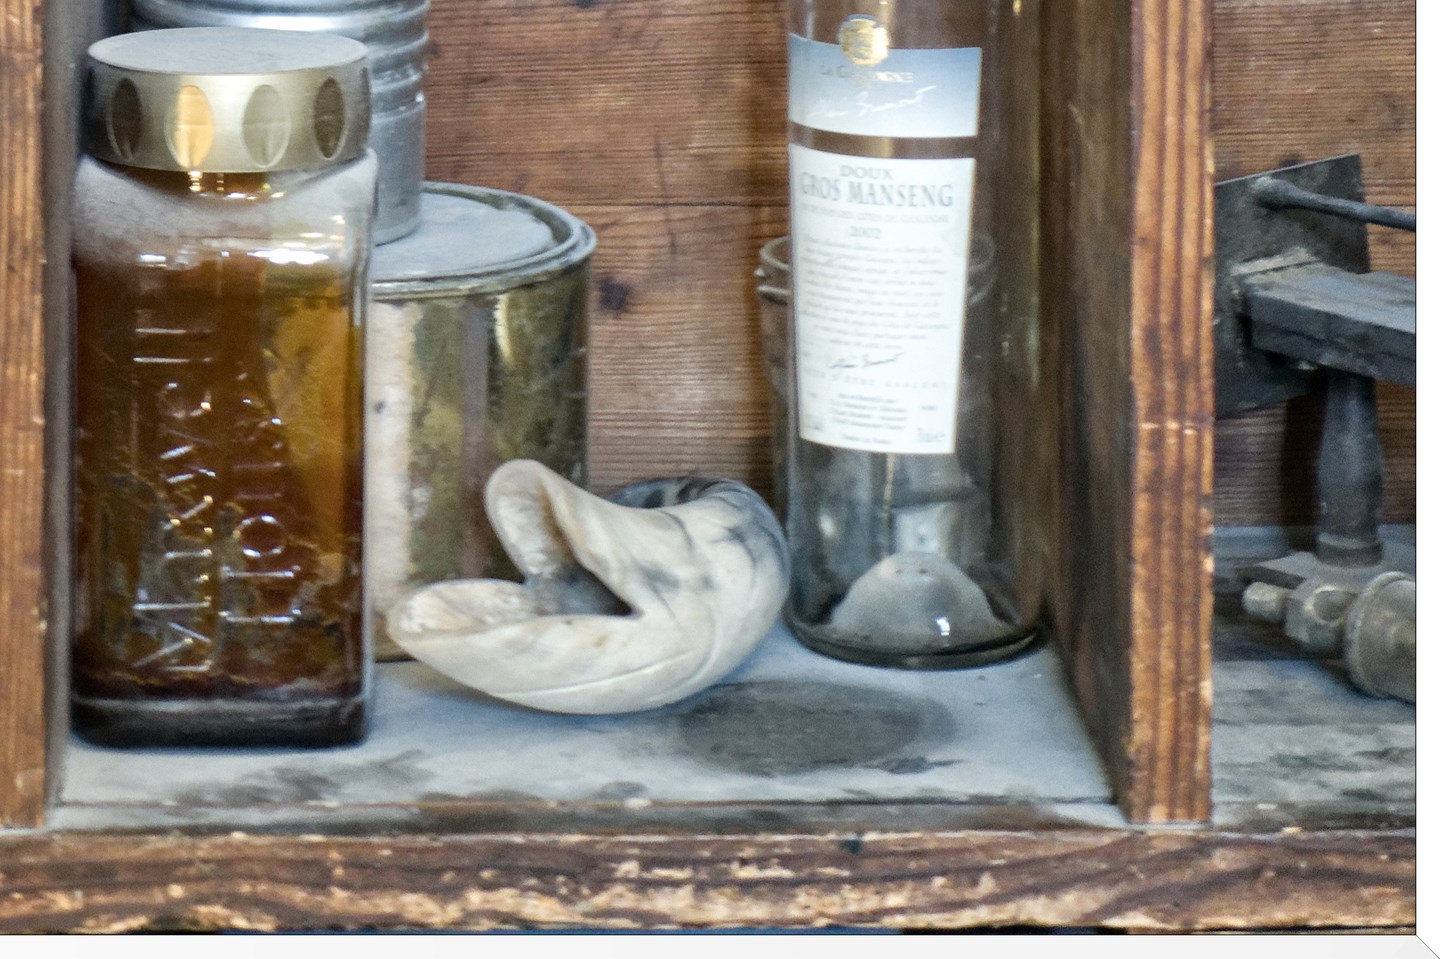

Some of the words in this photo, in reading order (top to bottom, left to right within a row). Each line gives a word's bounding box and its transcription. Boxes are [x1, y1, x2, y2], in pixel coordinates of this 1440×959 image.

[840, 164, 895, 180] DOUX
[799, 171, 841, 201] GROS
[846, 181, 953, 208] MANSENG
